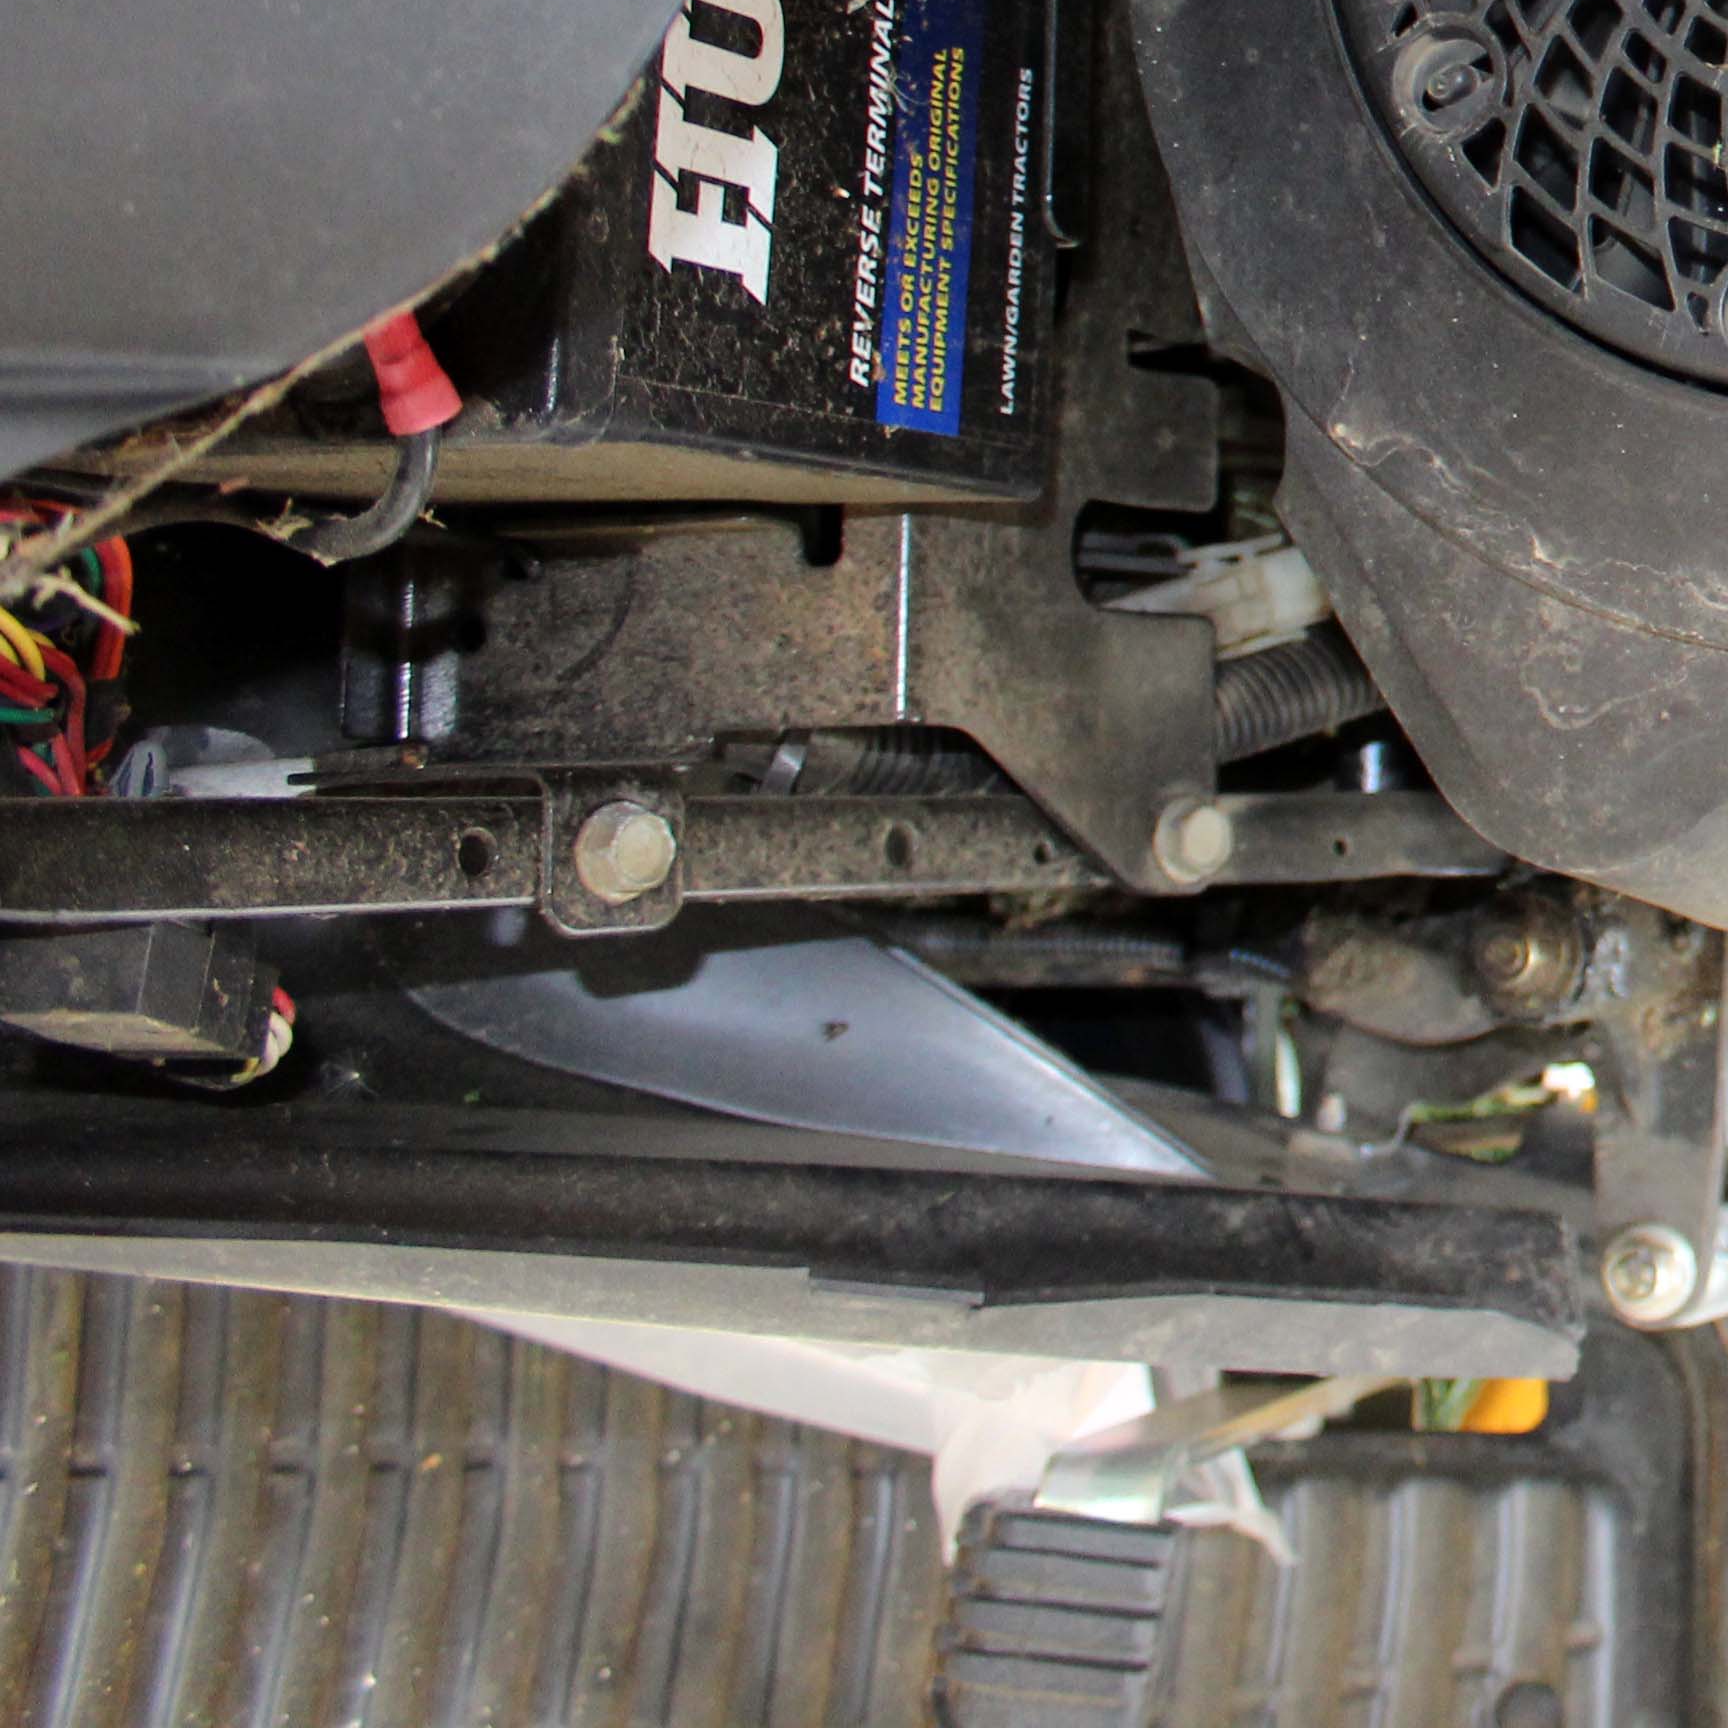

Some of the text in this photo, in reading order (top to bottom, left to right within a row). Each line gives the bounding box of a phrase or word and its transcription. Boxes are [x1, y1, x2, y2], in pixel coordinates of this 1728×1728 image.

[850, 198, 882, 387] REVERSE
[894, 152, 924, 406] MEETS OR EXCEEDS
[911, 48, 948, 409] MANUFACTURING ORIGINAL
[930, 47, 964, 412] EQUIPMENT SPECIFICATIONS
[1000, 68, 1033, 415] LAWN/GARDEN TRACTORS
